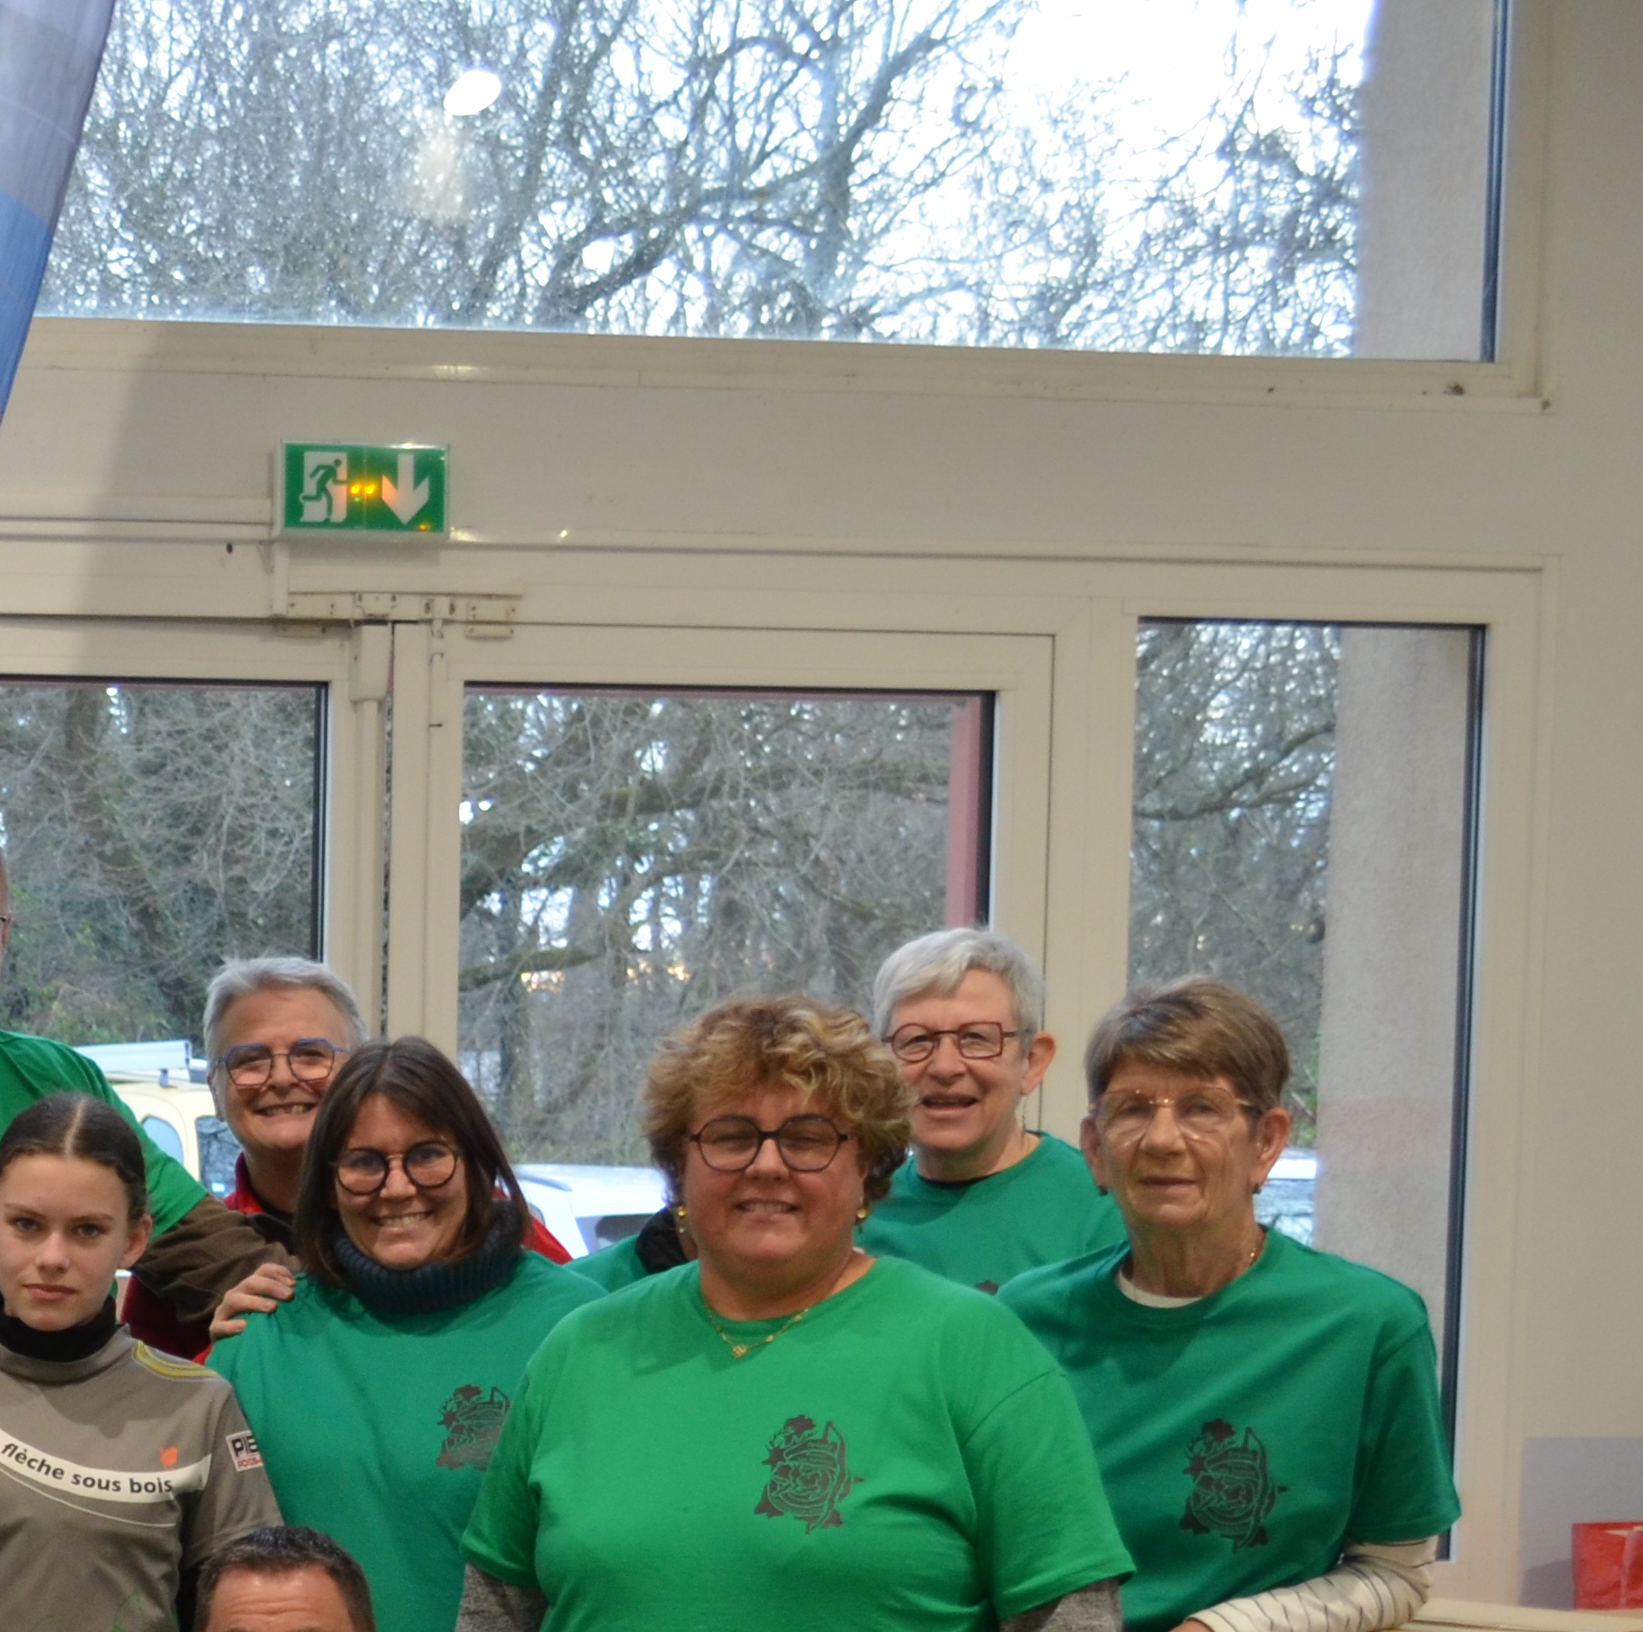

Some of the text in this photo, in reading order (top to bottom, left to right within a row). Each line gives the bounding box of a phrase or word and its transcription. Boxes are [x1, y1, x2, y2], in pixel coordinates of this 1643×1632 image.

[0, 1441, 65, 1480] flèche
[70, 1472, 122, 1493] sous
[128, 1478, 174, 1495] bois
